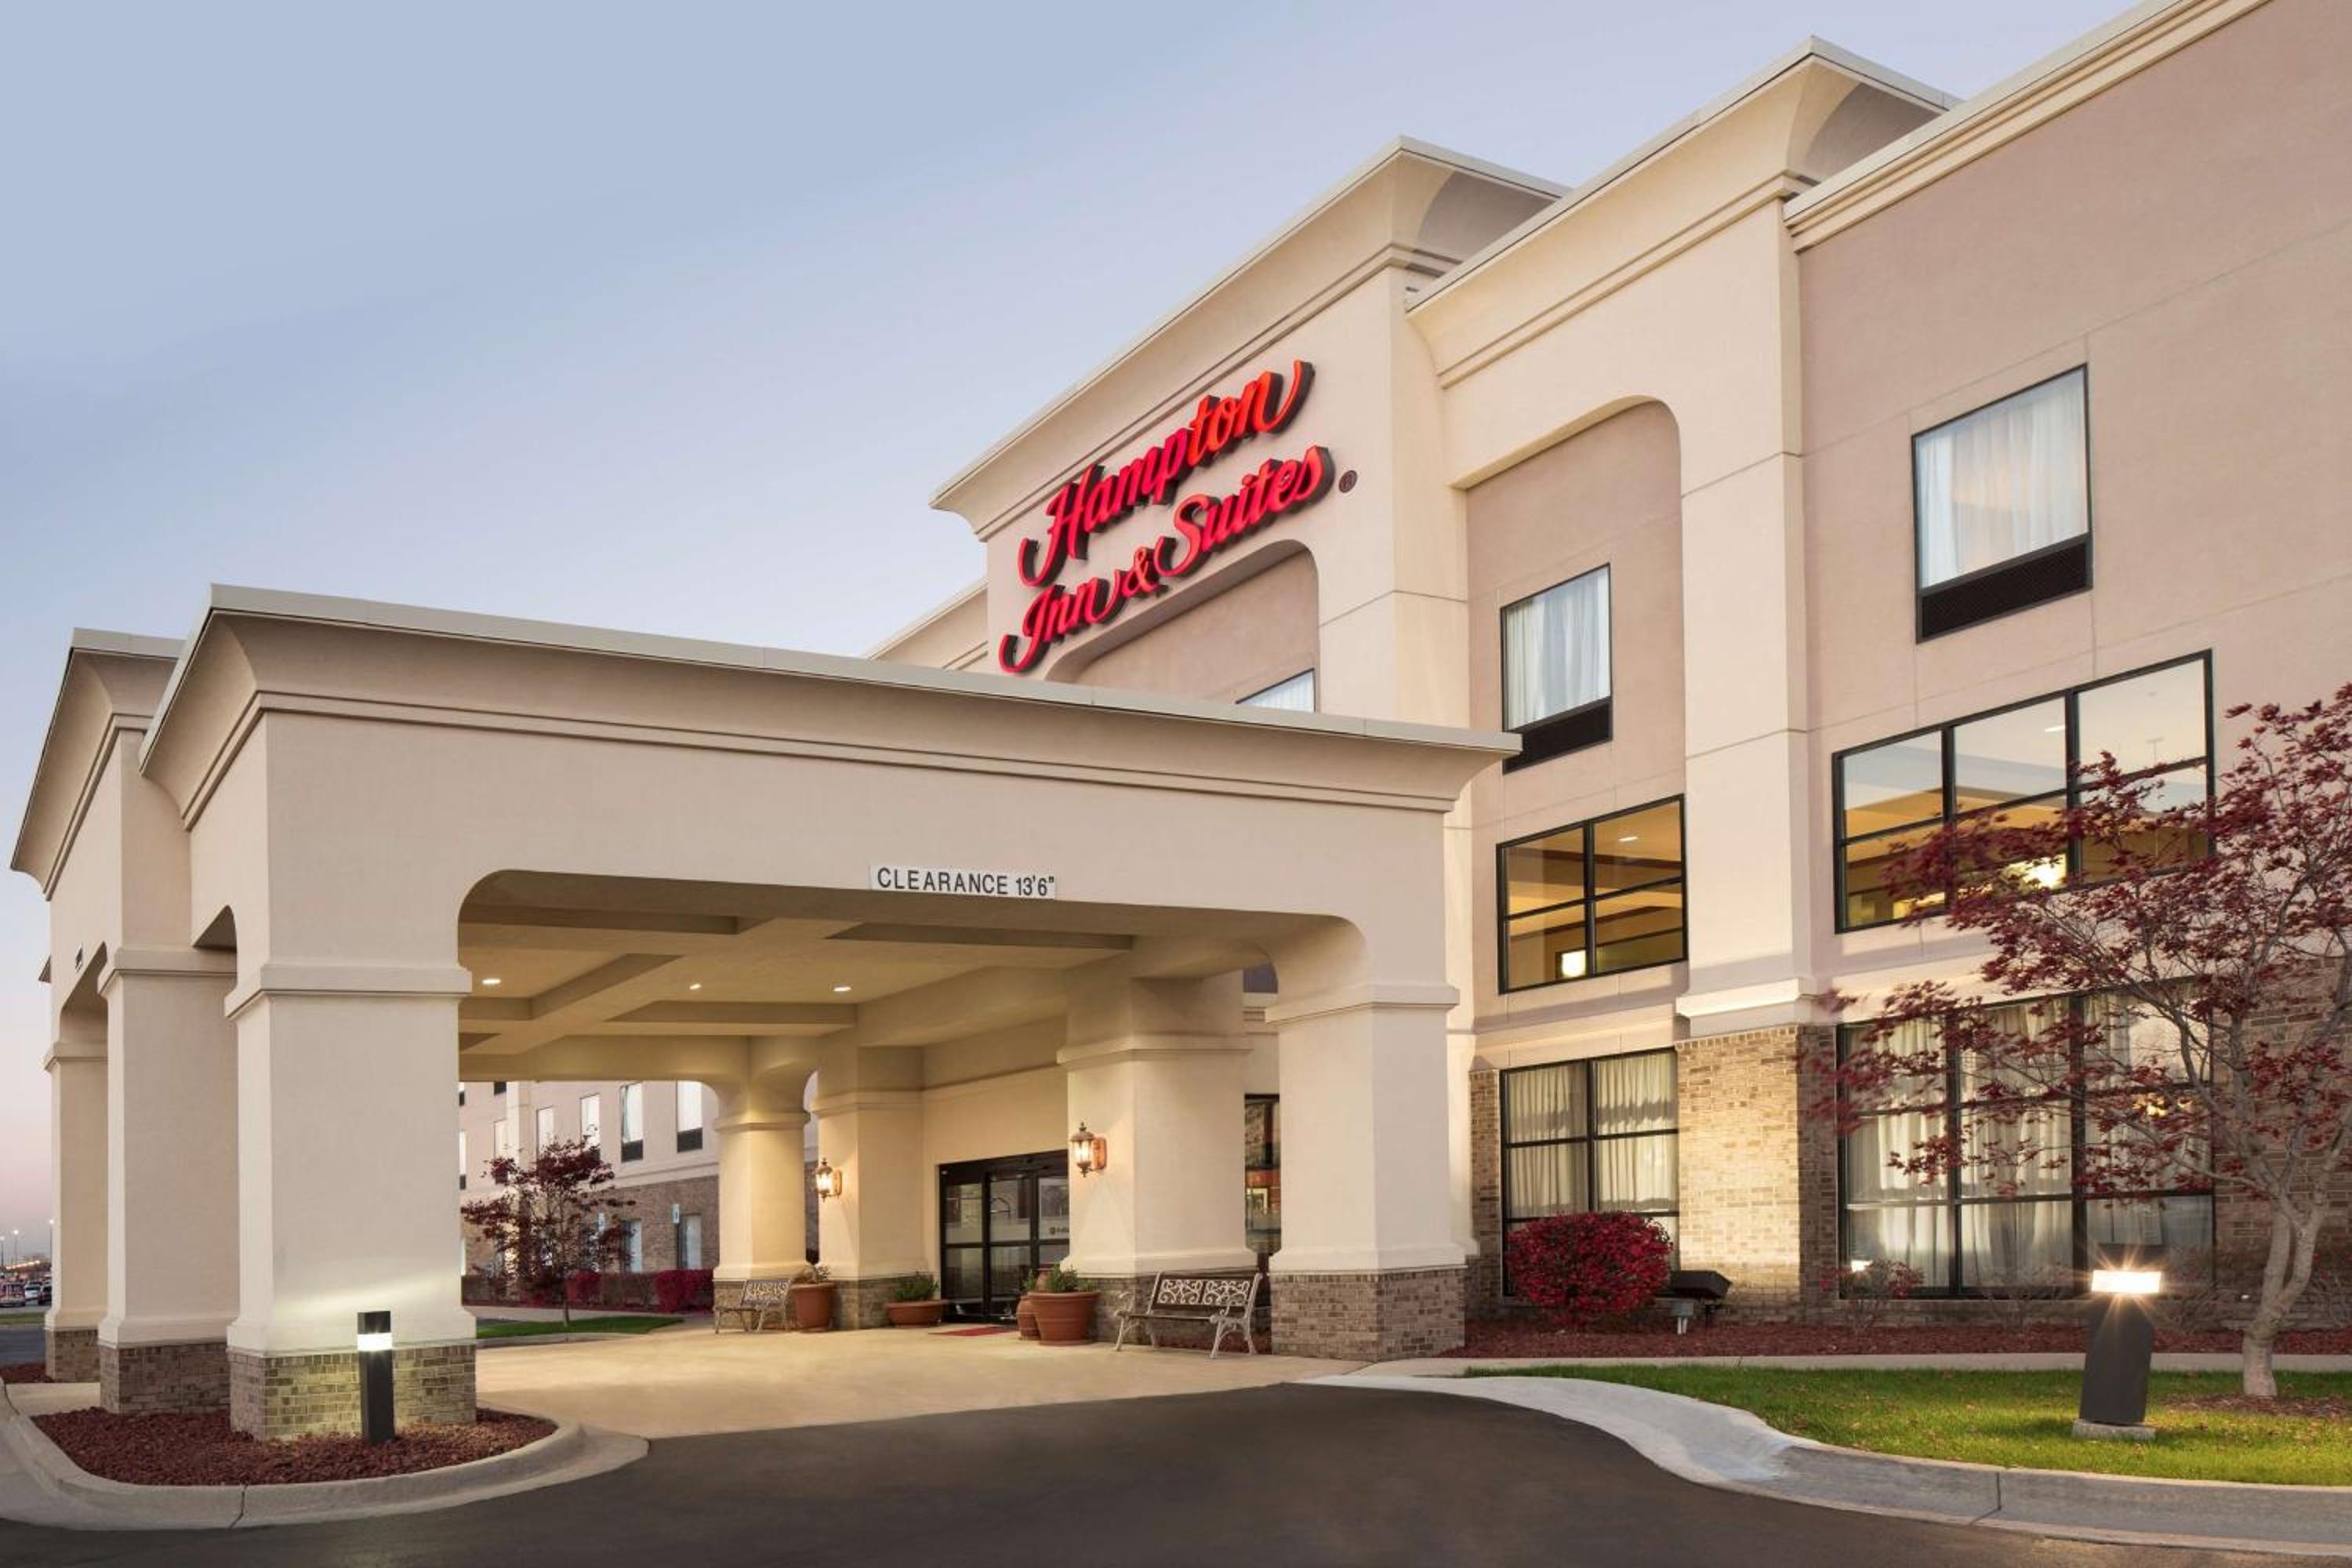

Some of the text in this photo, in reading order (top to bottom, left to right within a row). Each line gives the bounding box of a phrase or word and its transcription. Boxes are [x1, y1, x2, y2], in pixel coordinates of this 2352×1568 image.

[999, 445, 1332, 673] Inn & Suites
[1018, 360, 1313, 586] Hampton
[877, 867, 1054, 896] CLEARANCE 13'6"
